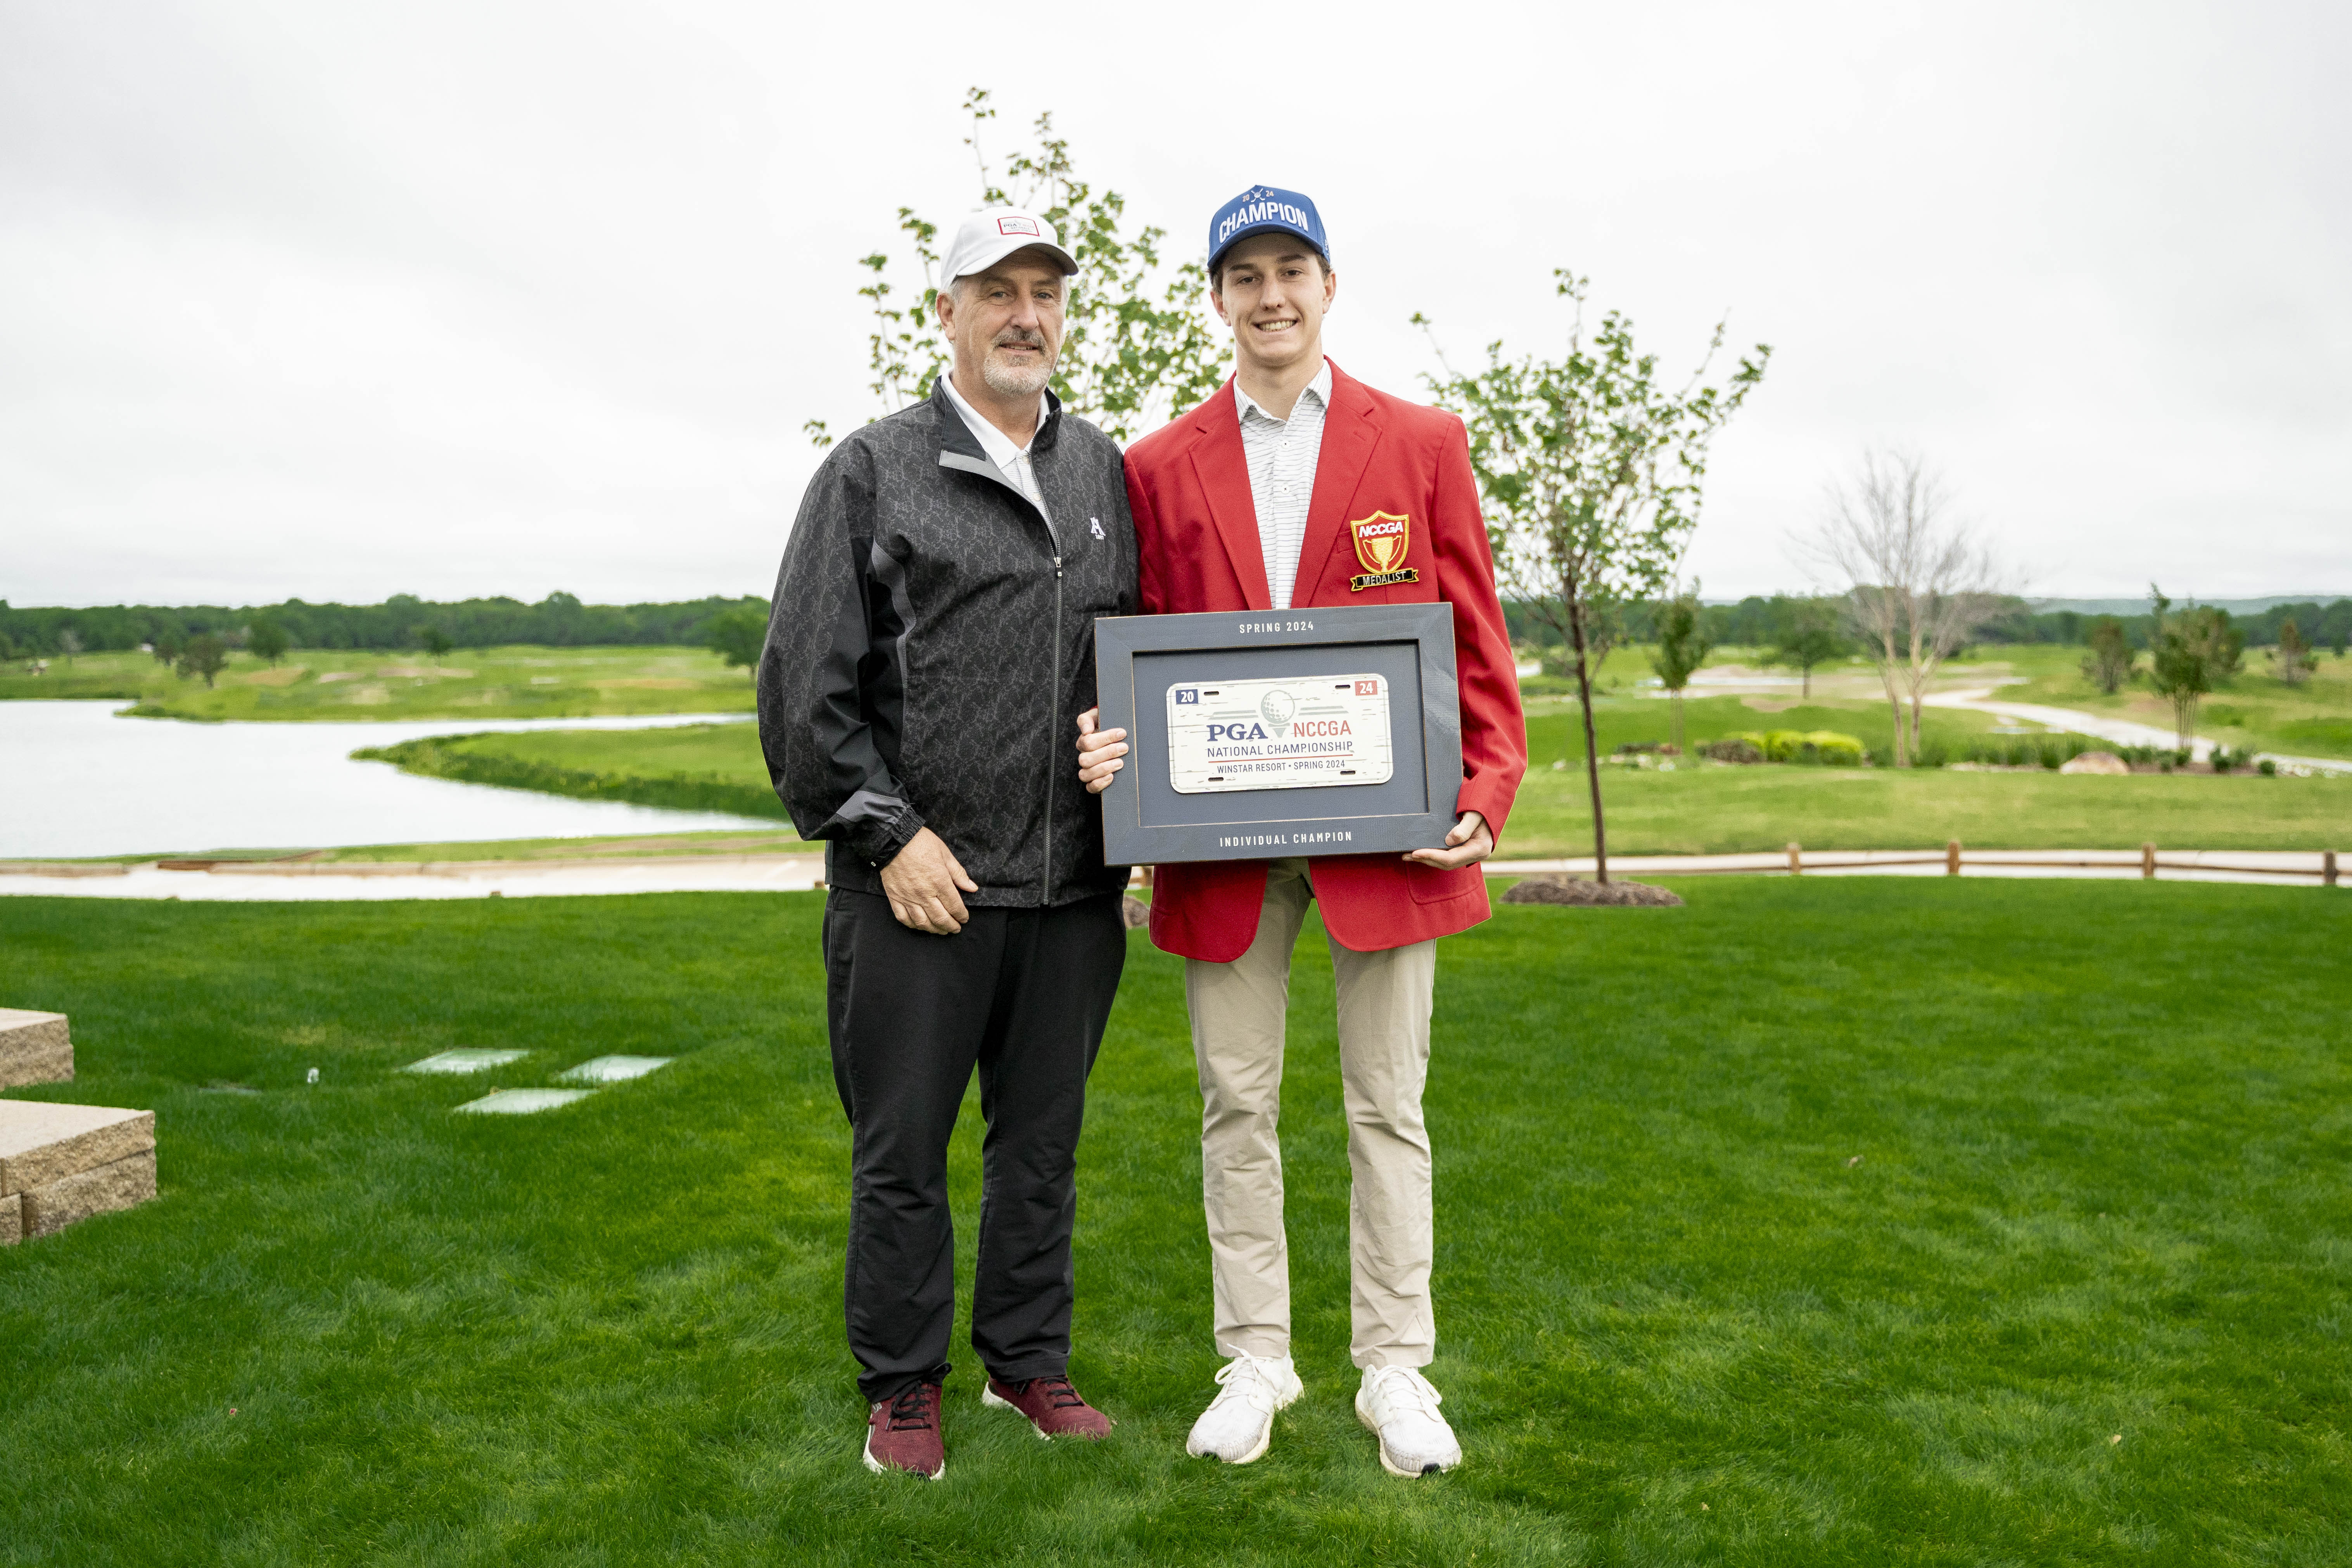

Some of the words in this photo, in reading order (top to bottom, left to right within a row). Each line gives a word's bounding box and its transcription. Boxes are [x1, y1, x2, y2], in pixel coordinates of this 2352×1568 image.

[1219, 202, 1309, 244] CHAMPION
[1358, 521, 1404, 538] NCCGA
[1362, 570, 1407, 586] MEDALIST
[1239, 622, 1280, 634] SPRING
[1286, 621, 1314, 631] 2024
[1359, 682, 1374, 694] 24
[1180, 691, 1194, 703] 20
[1206, 723, 1268, 742] PGA
[1293, 720, 1352, 738] NCCGA
[1207, 745, 1263, 757] NATIONAL
[1267, 741, 1353, 755] CHAMPIONSHIP
[1217, 764, 1253, 774] WINSTAR
[1256, 762, 1286, 772] RESORT
[1294, 761, 1323, 770] SPRING
[1326, 759, 1345, 768] 2024
[1220, 834, 1287, 847] INDIVIDUAL
[1293, 831, 1352, 844] CHAMPION
